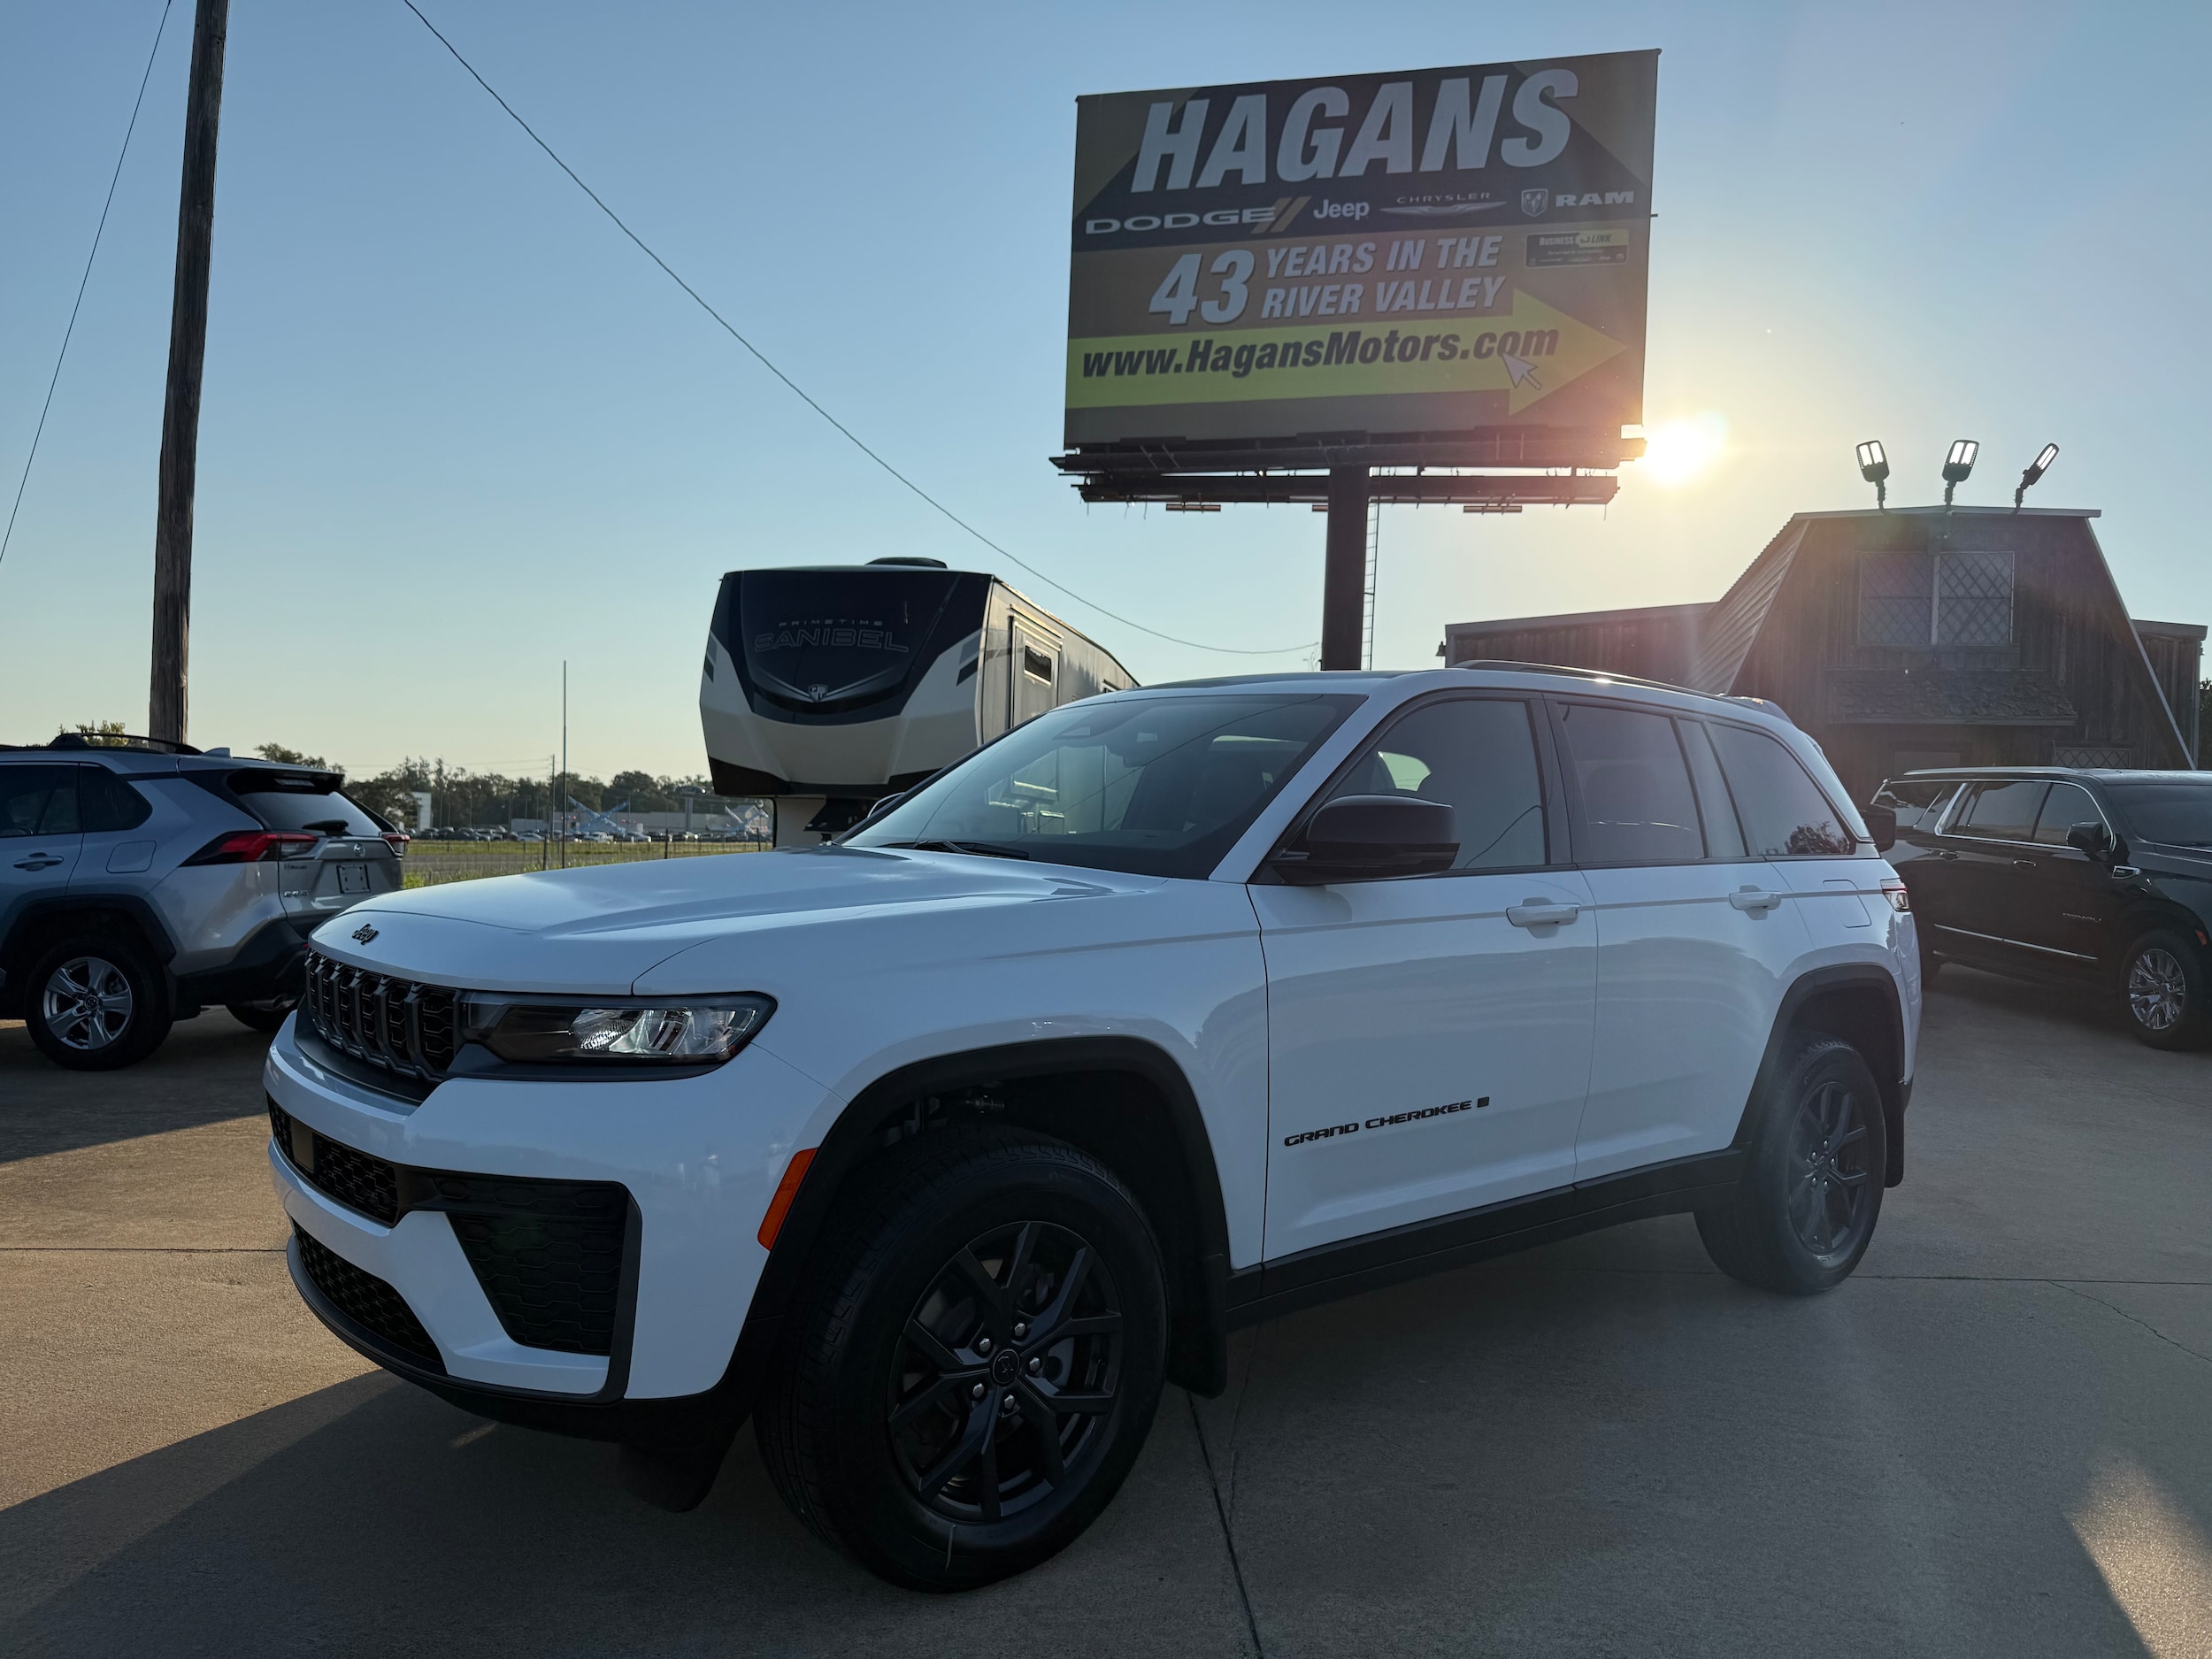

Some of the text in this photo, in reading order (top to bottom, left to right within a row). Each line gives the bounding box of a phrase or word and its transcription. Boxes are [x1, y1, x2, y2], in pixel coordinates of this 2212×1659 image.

[1131, 69, 1578, 193] HAGANS
[1313, 199, 1370, 220] Jeep
[1397, 192, 1491, 204] CHRYSLER
[1555, 191, 1634, 207] RAM
[1086, 208, 1276, 234] DODGE
[1592, 234, 1611, 243] LINK
[1265, 235, 1502, 278] YEARS IN THE
[1148, 250, 1256, 325] 43
[1262, 276, 1506, 319] RIVER VALLEY
[1083, 329, 1558, 378] www.HagansMotors.com
[755, 628, 909, 653] SANIBEL
[352, 924, 379, 945] Jeep
[1284, 1101, 1472, 1147] GRAND CHEROKEE
